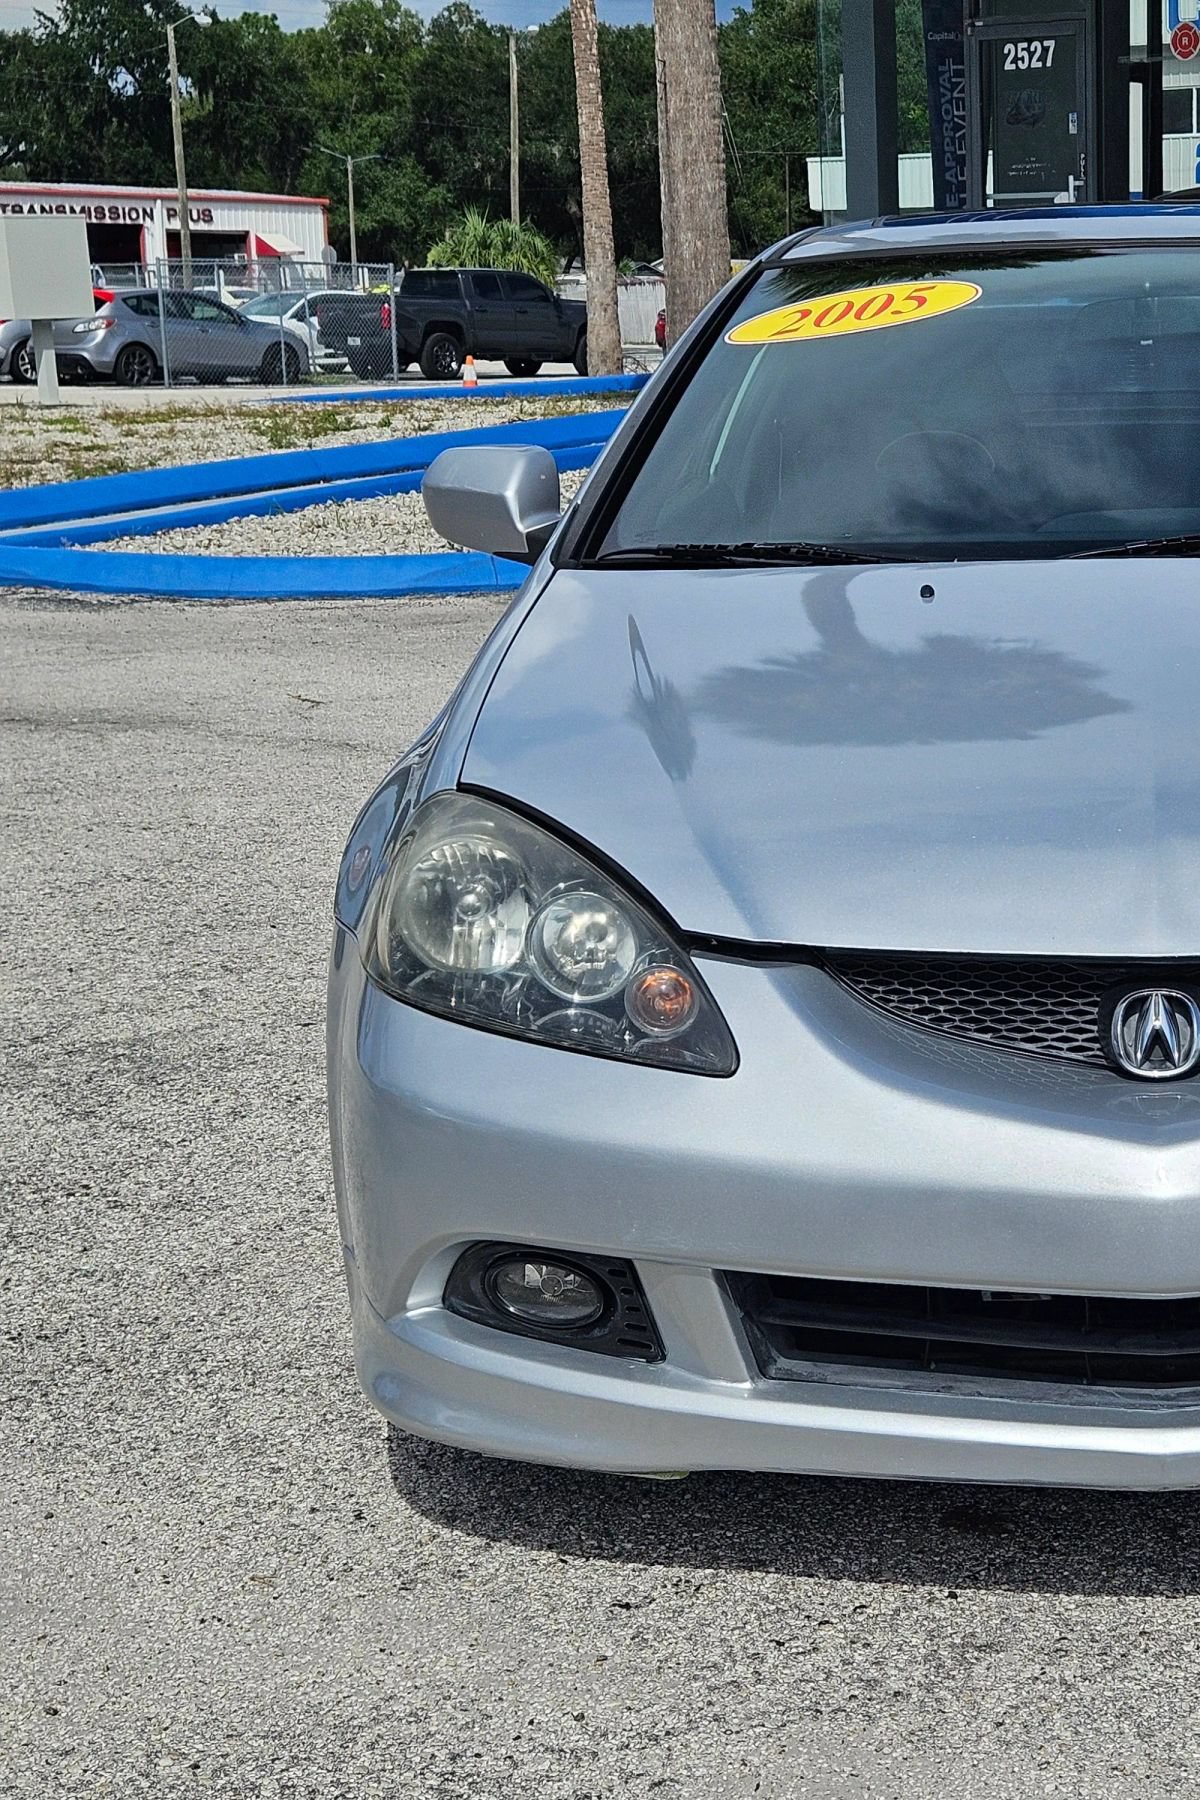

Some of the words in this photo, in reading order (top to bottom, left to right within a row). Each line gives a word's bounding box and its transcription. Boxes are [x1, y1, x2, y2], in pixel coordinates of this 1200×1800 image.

[1182, 36, 1189, 45] R
[1003, 40, 1056, 70] 2527
[166, 207, 214, 223] PUS
[768, 285, 937, 337] 2005
